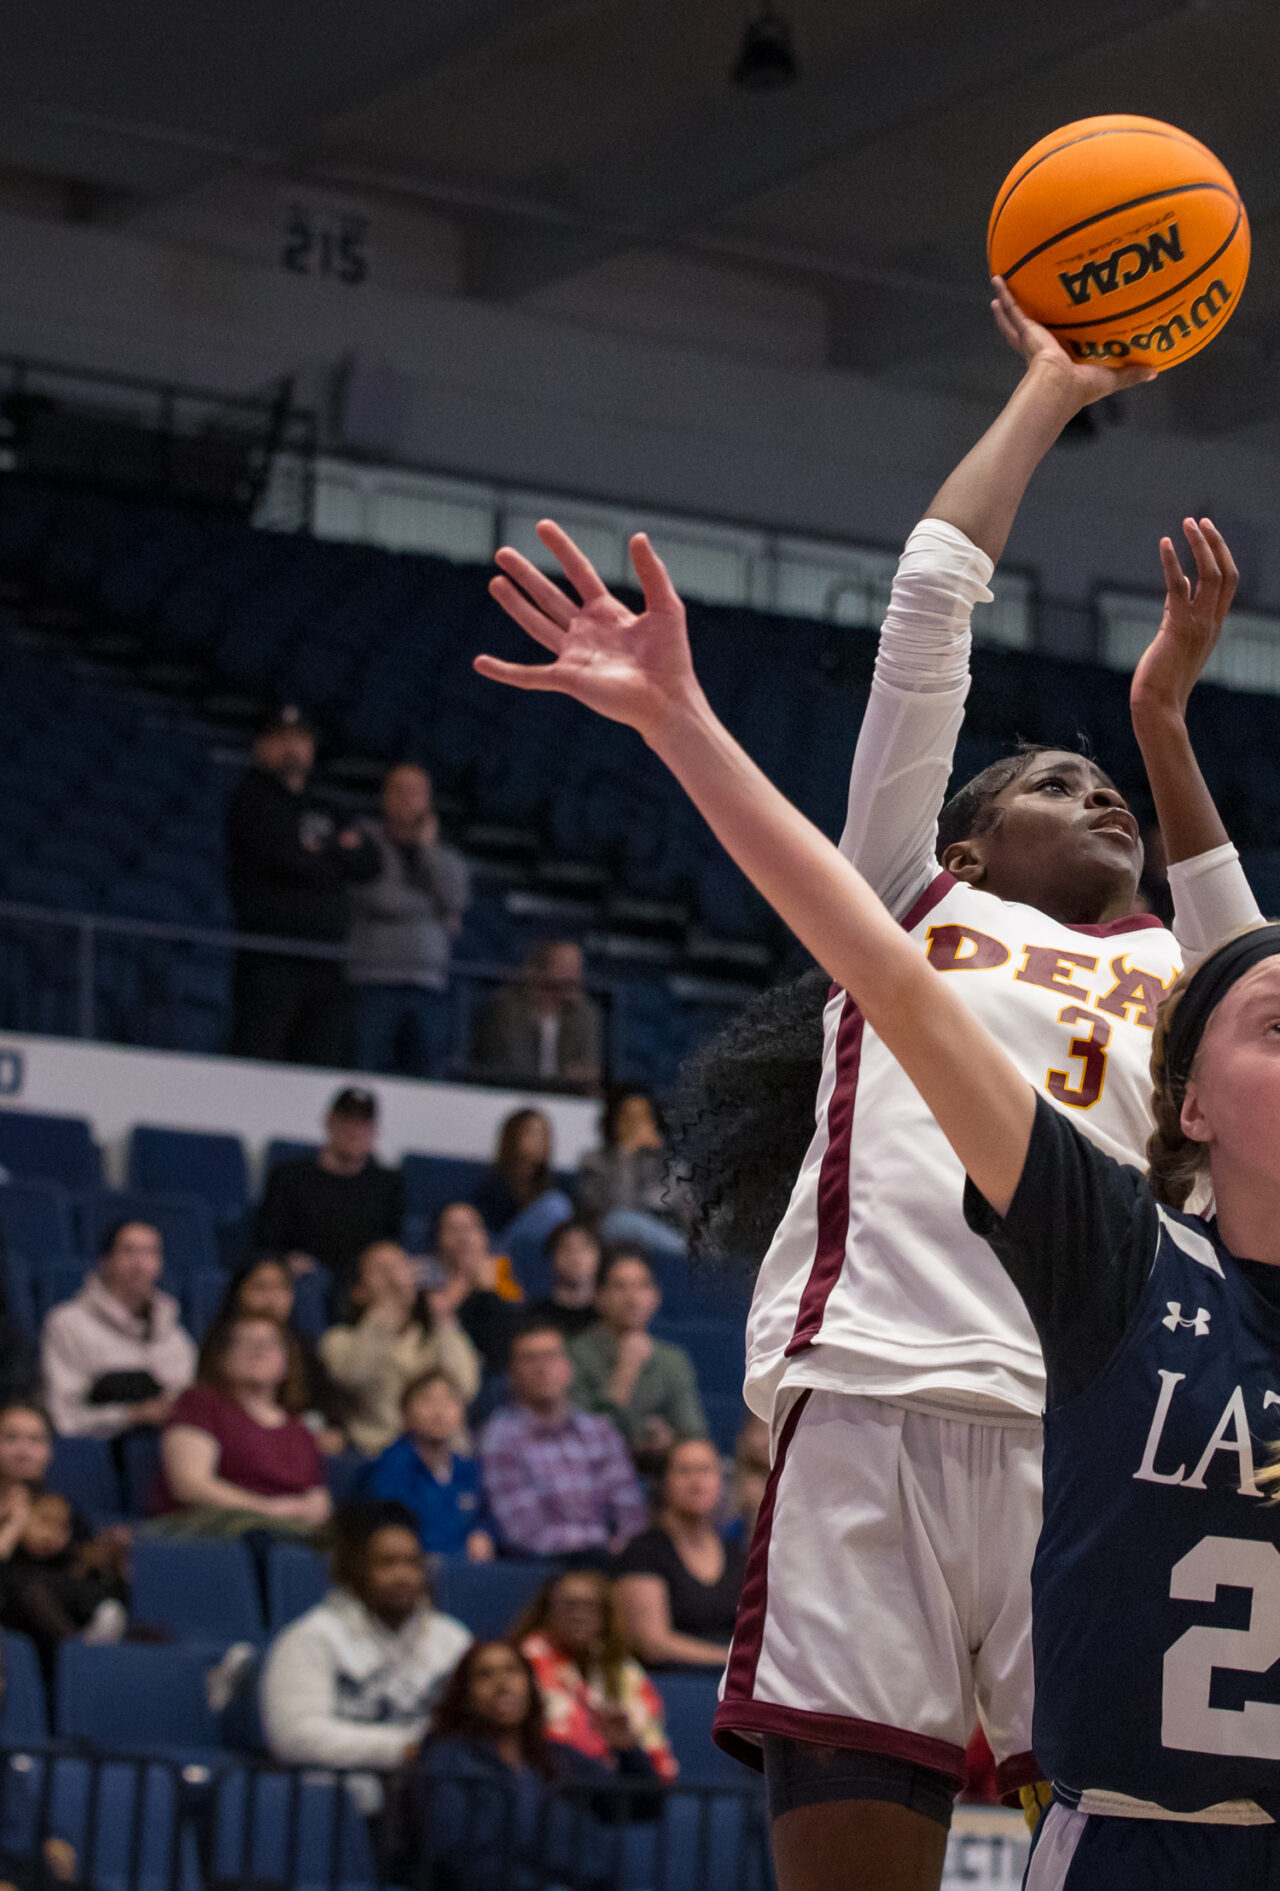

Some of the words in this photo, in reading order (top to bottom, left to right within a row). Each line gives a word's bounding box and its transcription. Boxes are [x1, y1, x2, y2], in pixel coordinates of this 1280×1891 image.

[281, 208, 370, 286] 215
[1057, 221, 1186, 307] NCAA
[1068, 278, 1232, 360] Wilson
[1045, 1004, 1113, 1111] 3
